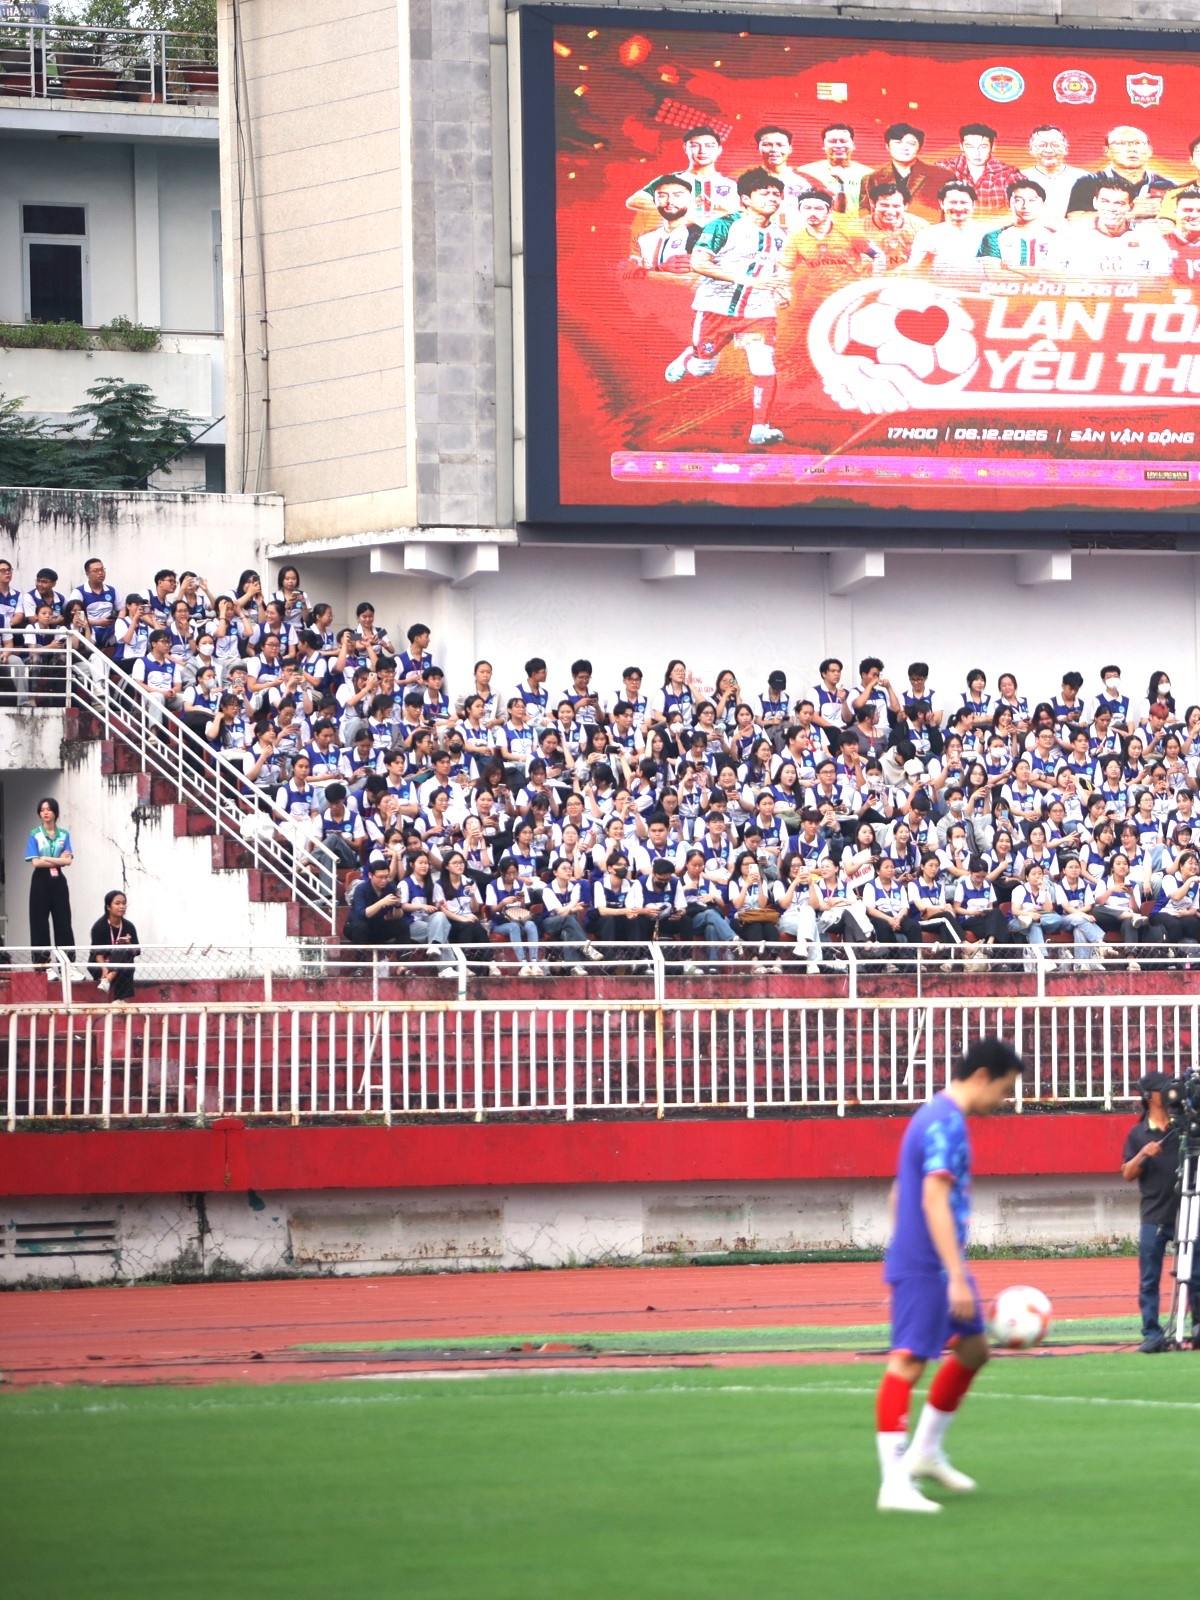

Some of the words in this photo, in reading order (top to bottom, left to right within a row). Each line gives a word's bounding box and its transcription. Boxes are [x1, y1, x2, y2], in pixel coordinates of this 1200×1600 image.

[984, 296, 1109, 341] LAN
[983, 339, 1104, 392] YÊU
[1070, 428, 1105, 442] SÂN
[1110, 428, 1144, 445] VẬN
[1148, 429, 1195, 446] ĐỘNG
